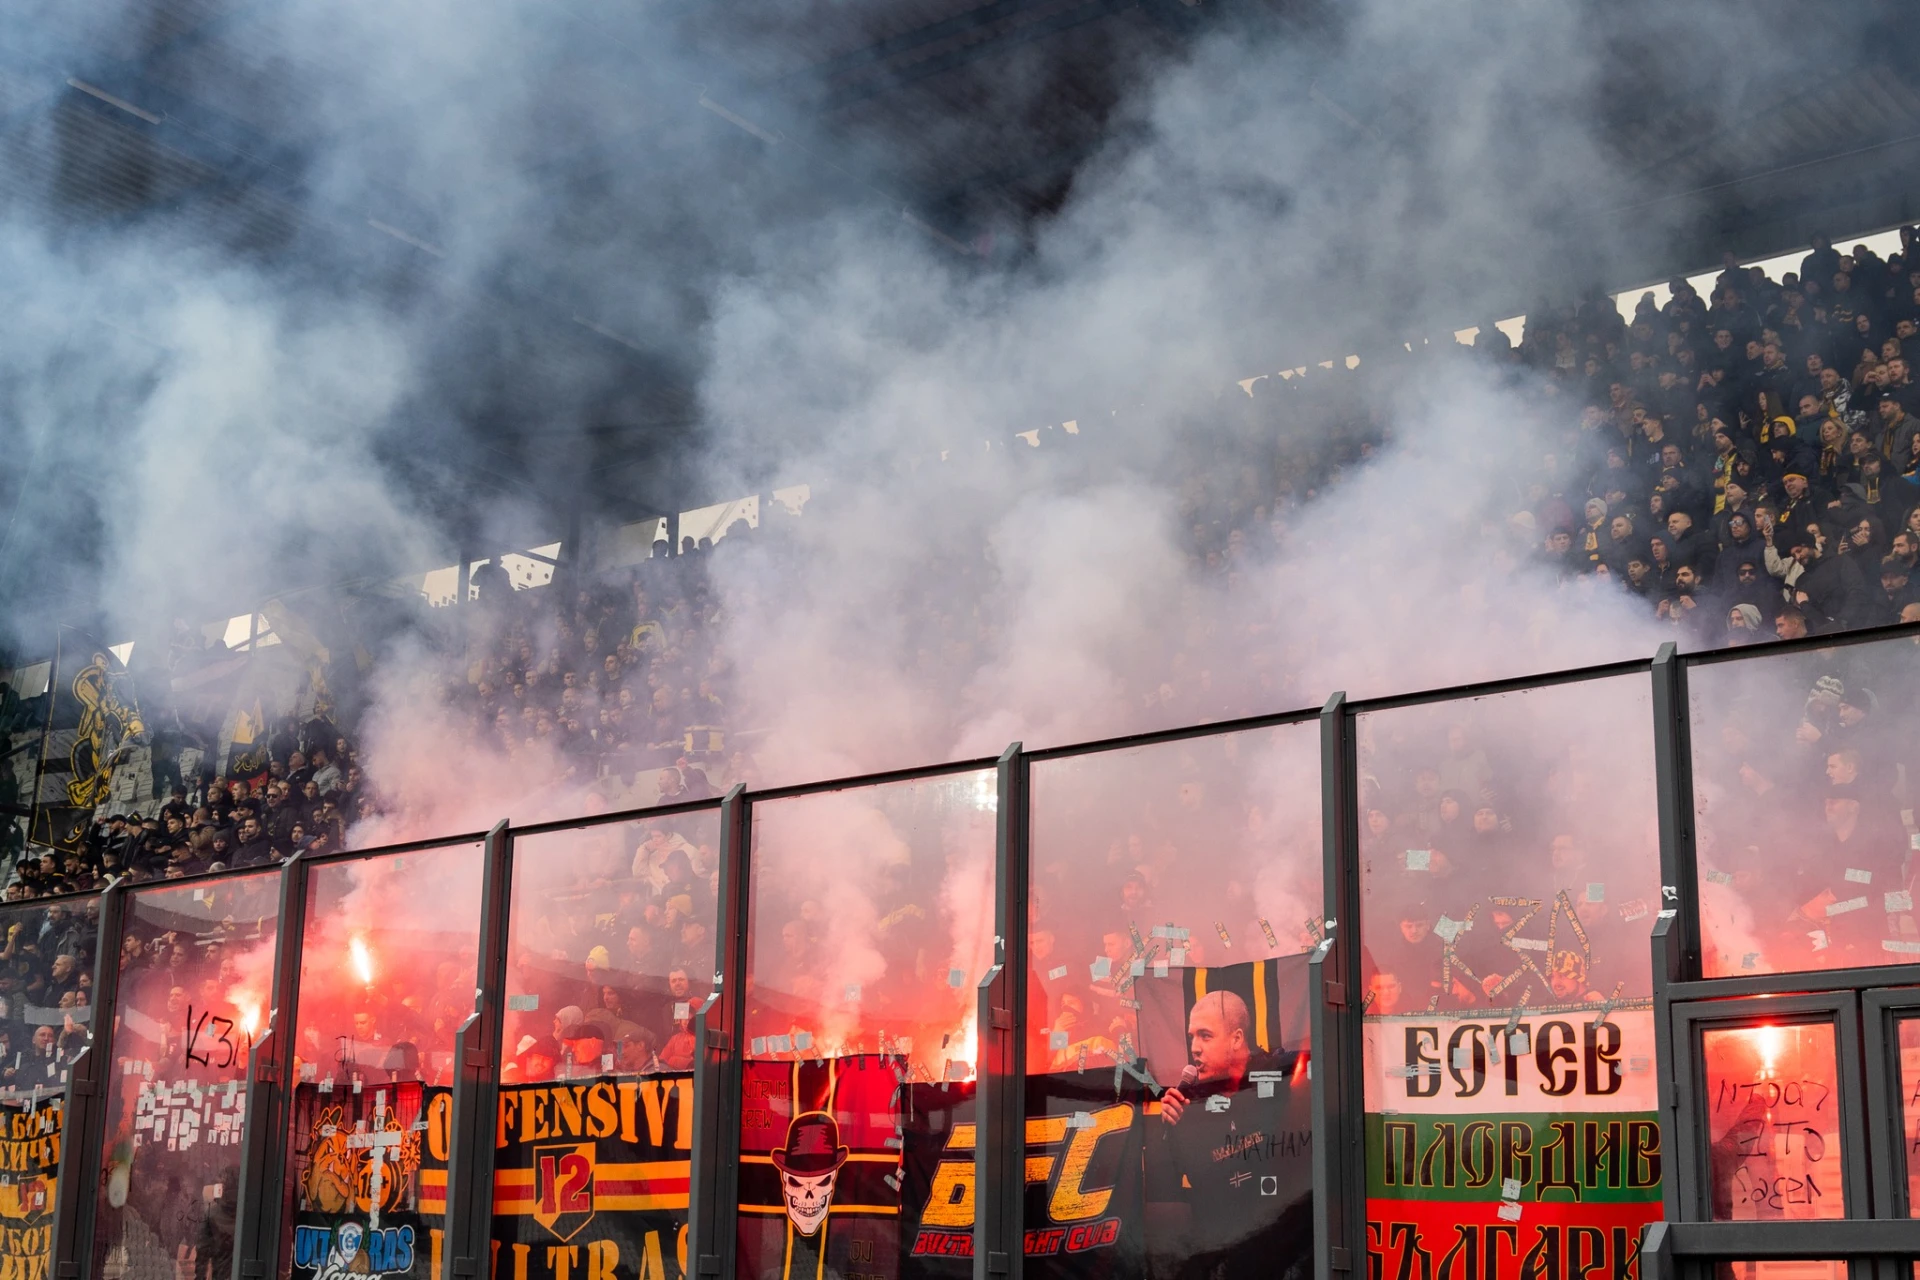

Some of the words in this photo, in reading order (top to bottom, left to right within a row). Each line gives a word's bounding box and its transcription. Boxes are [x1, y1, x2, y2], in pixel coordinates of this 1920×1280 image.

[1405, 1021, 1622, 1097] БОТЕВ
[12, 1106, 60, 1139] БОТ
[427, 1078, 692, 1161] OFENSIV
[538, 1153, 591, 1215] 12
[1384, 1121, 1662, 1203] ПЛОВДИВ
[914, 1232, 974, 1255] BULTR
[1067, 1219, 1119, 1251] CLUB
[1366, 1221, 1644, 1280] БЪЛГАРИ
